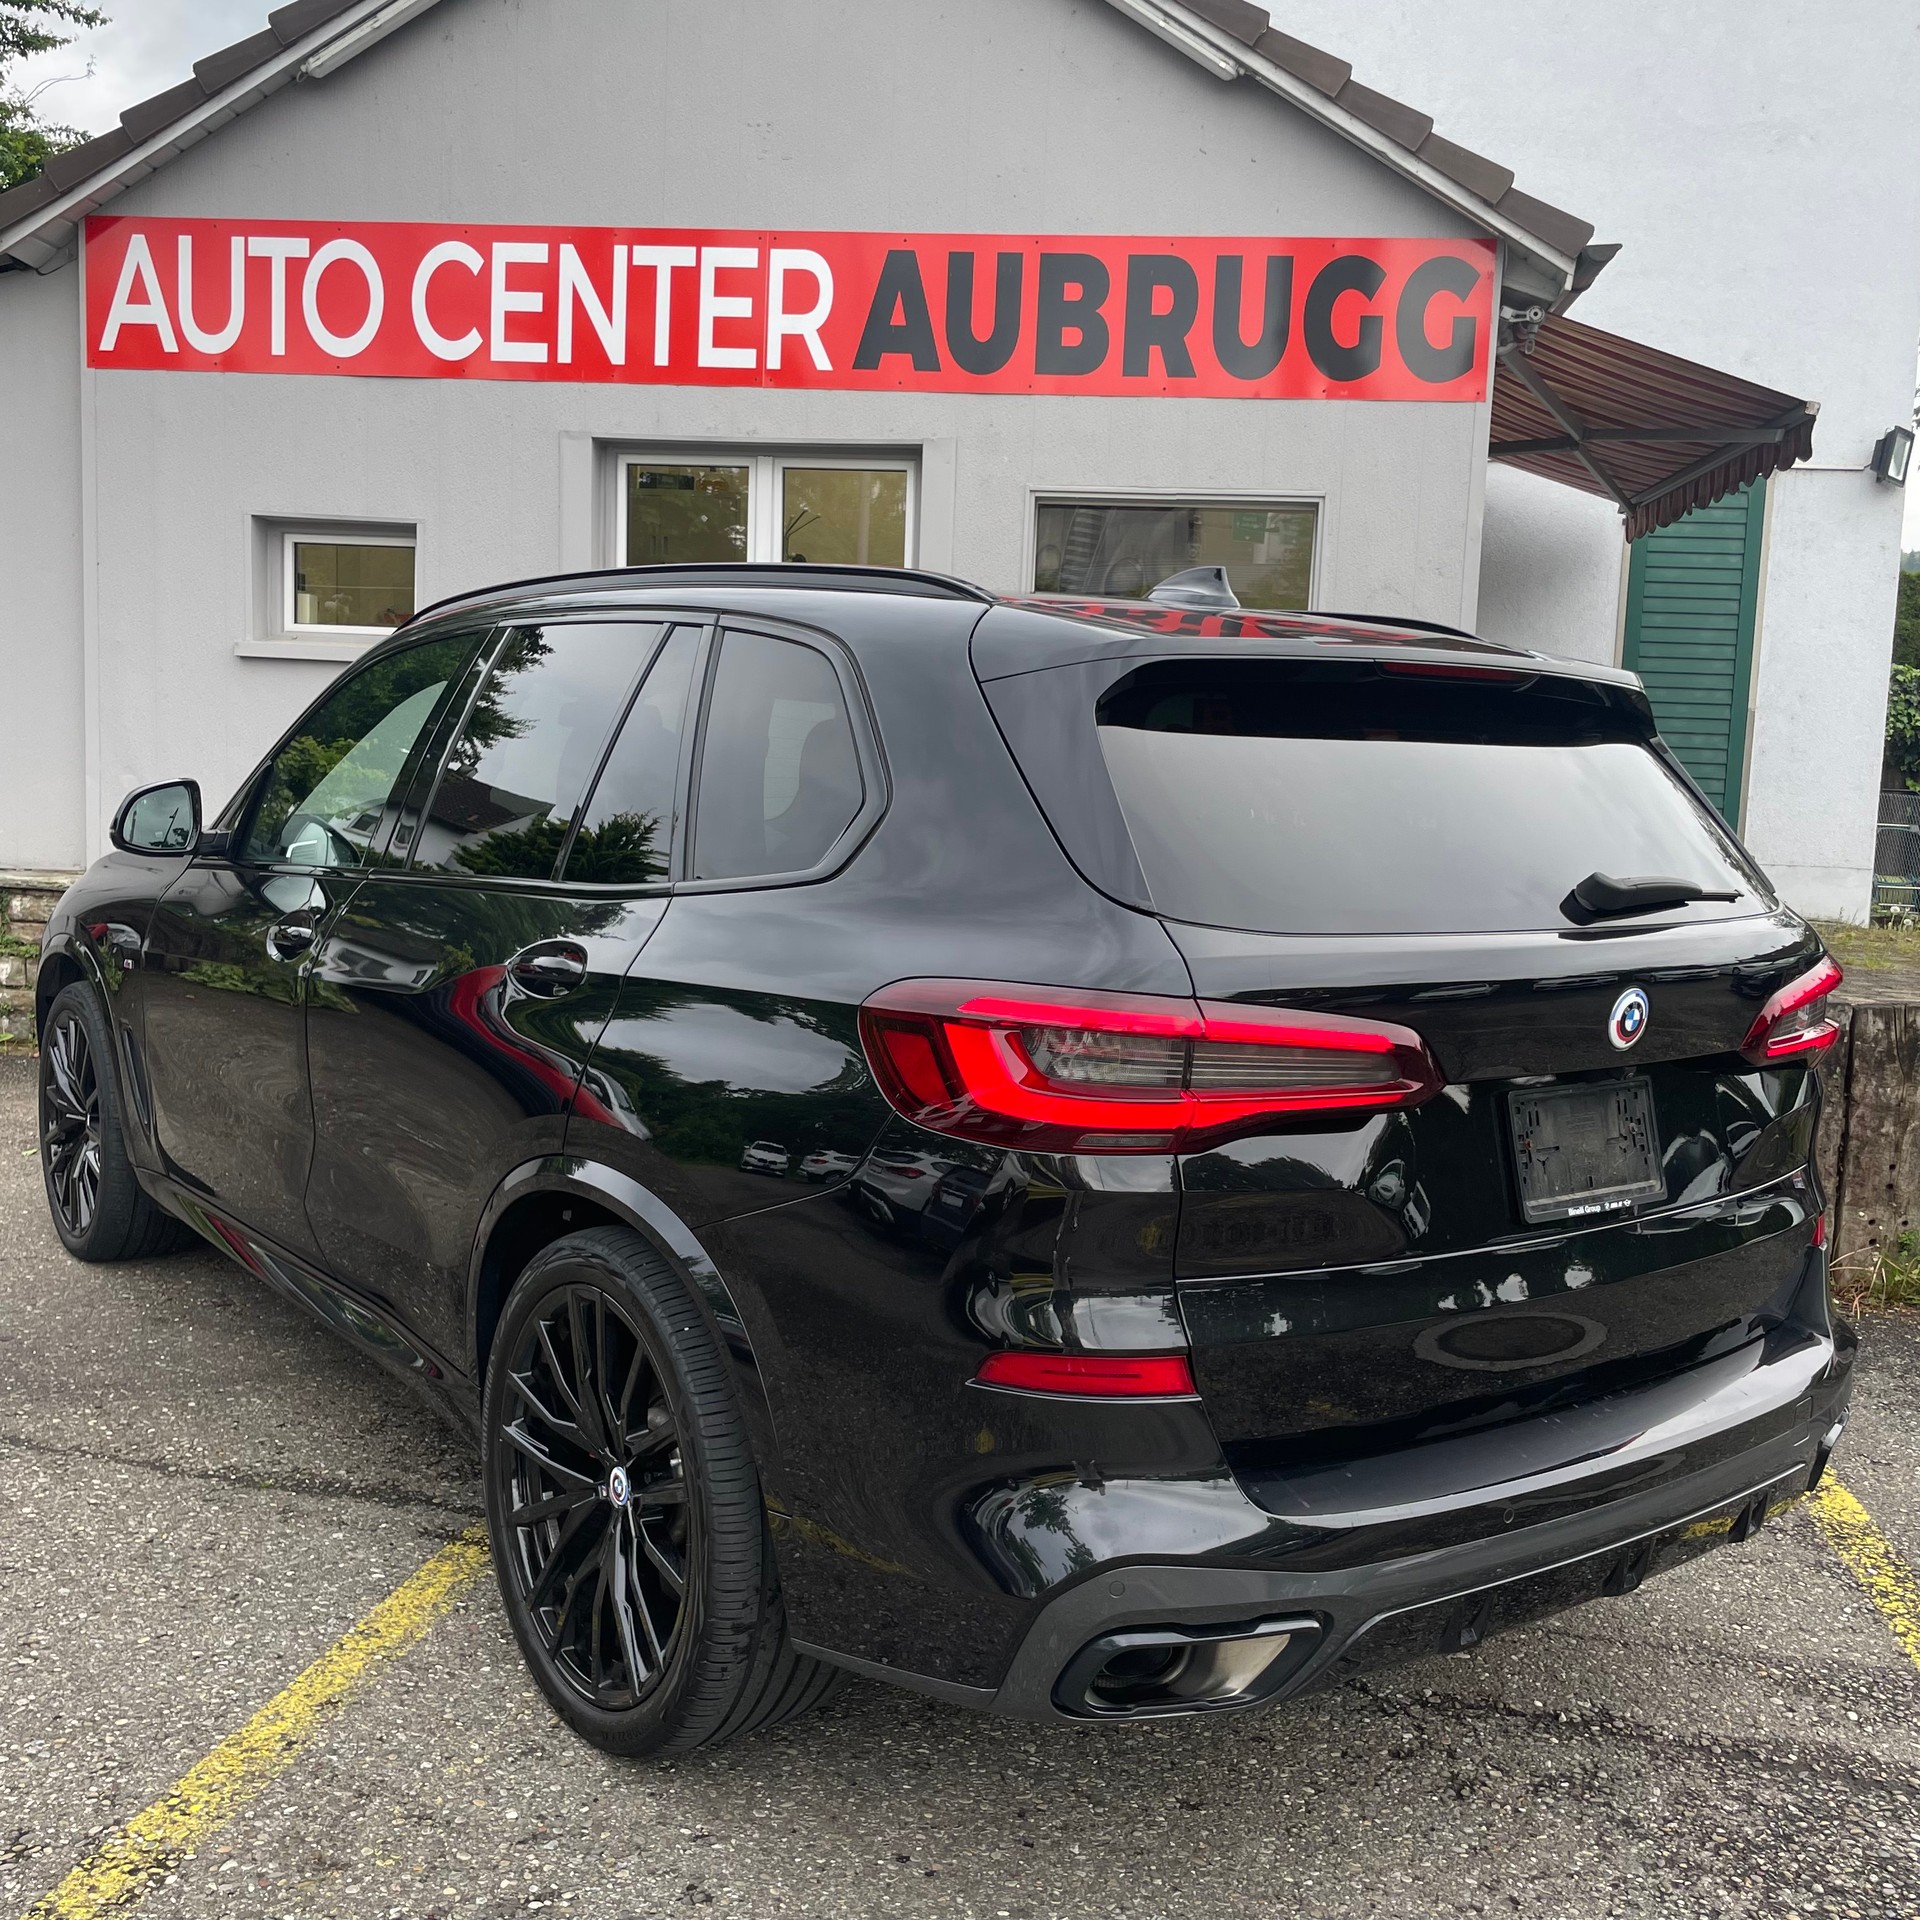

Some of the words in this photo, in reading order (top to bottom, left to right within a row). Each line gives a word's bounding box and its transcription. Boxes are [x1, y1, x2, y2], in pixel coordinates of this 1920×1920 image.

[98, 233, 385, 358] AUTO
[410, 240, 835, 373] CENTER
[853, 249, 1481, 383] AUBRUGG
[1585, 1205, 1601, 1213] Group
